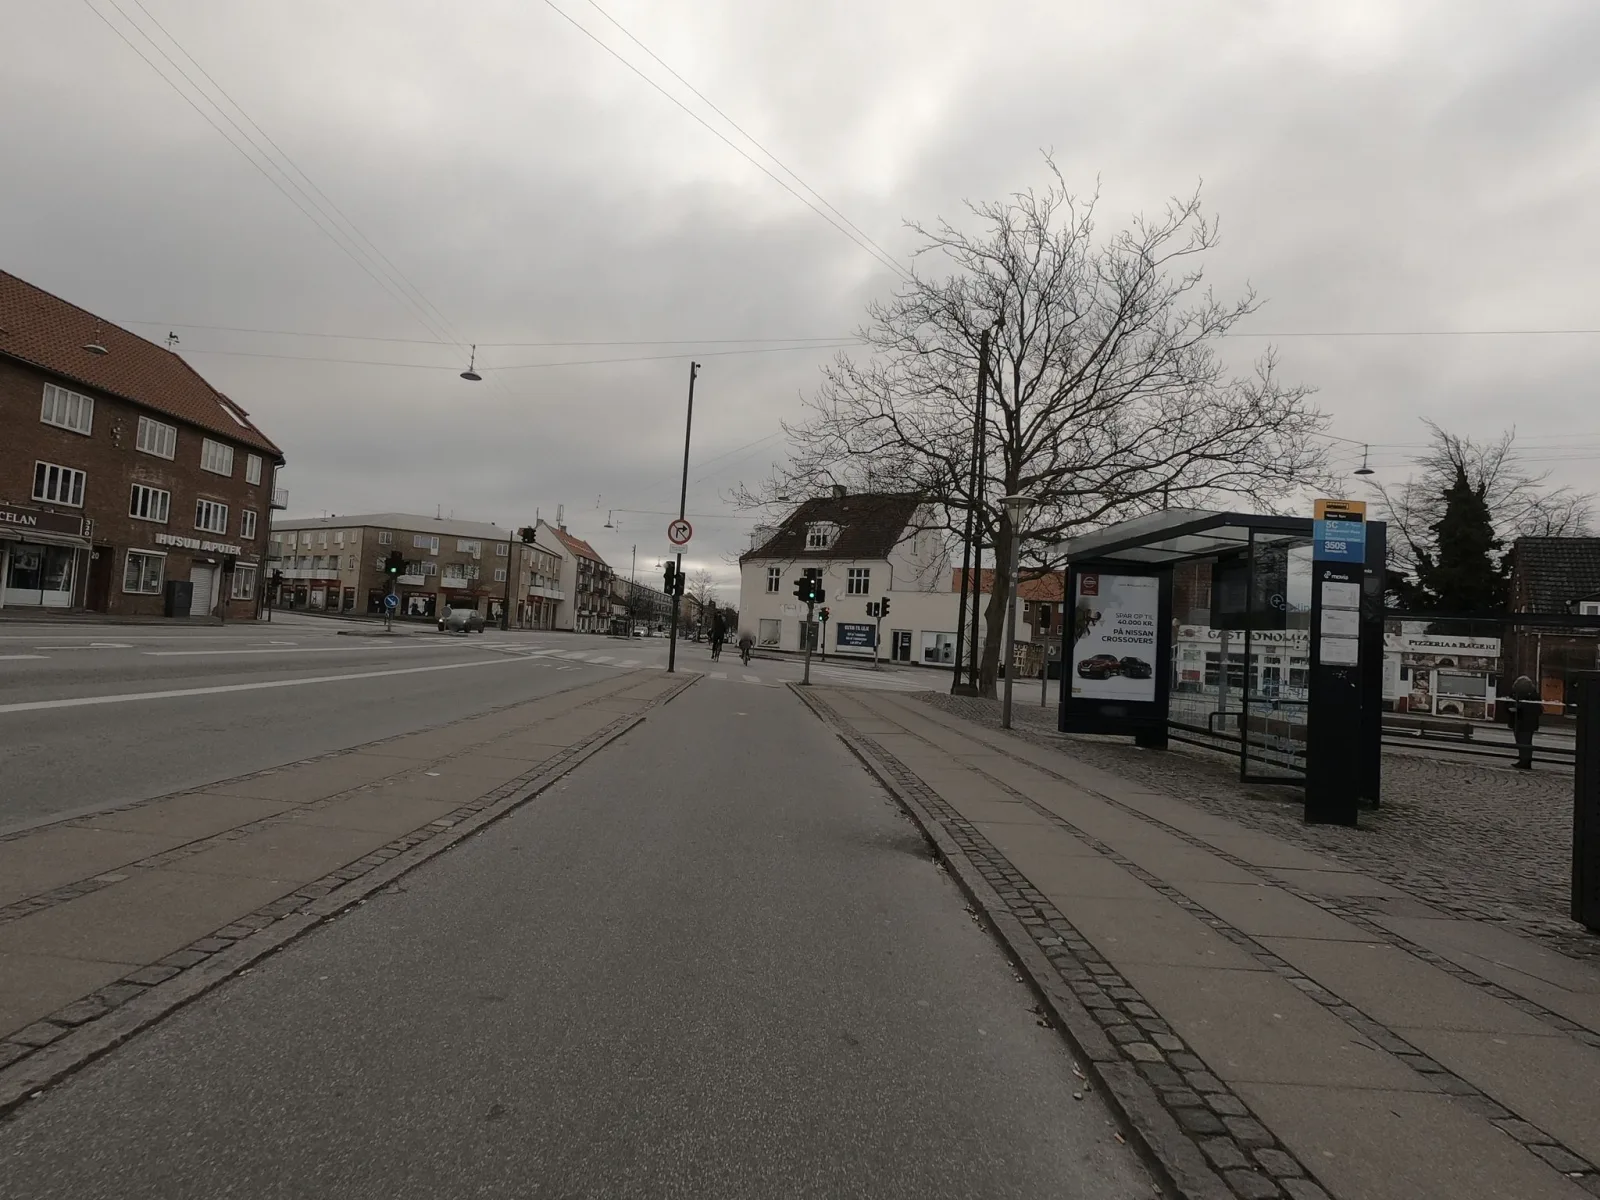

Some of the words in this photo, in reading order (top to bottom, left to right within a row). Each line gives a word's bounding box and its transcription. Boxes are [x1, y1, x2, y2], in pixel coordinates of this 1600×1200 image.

[0, 511, 37, 526] CELAN
[1326, 521, 1338, 529] 5C
[155, 533, 200, 549] HUSUM
[201, 541, 241, 555] APOTEK
[1325, 541, 1347, 550] 350S
[1102, 636, 1153, 644] CROSSOVERS
[1207, 630, 1309, 642] GASTONOMIA
[1409, 640, 1450, 648] PIZZERIA
